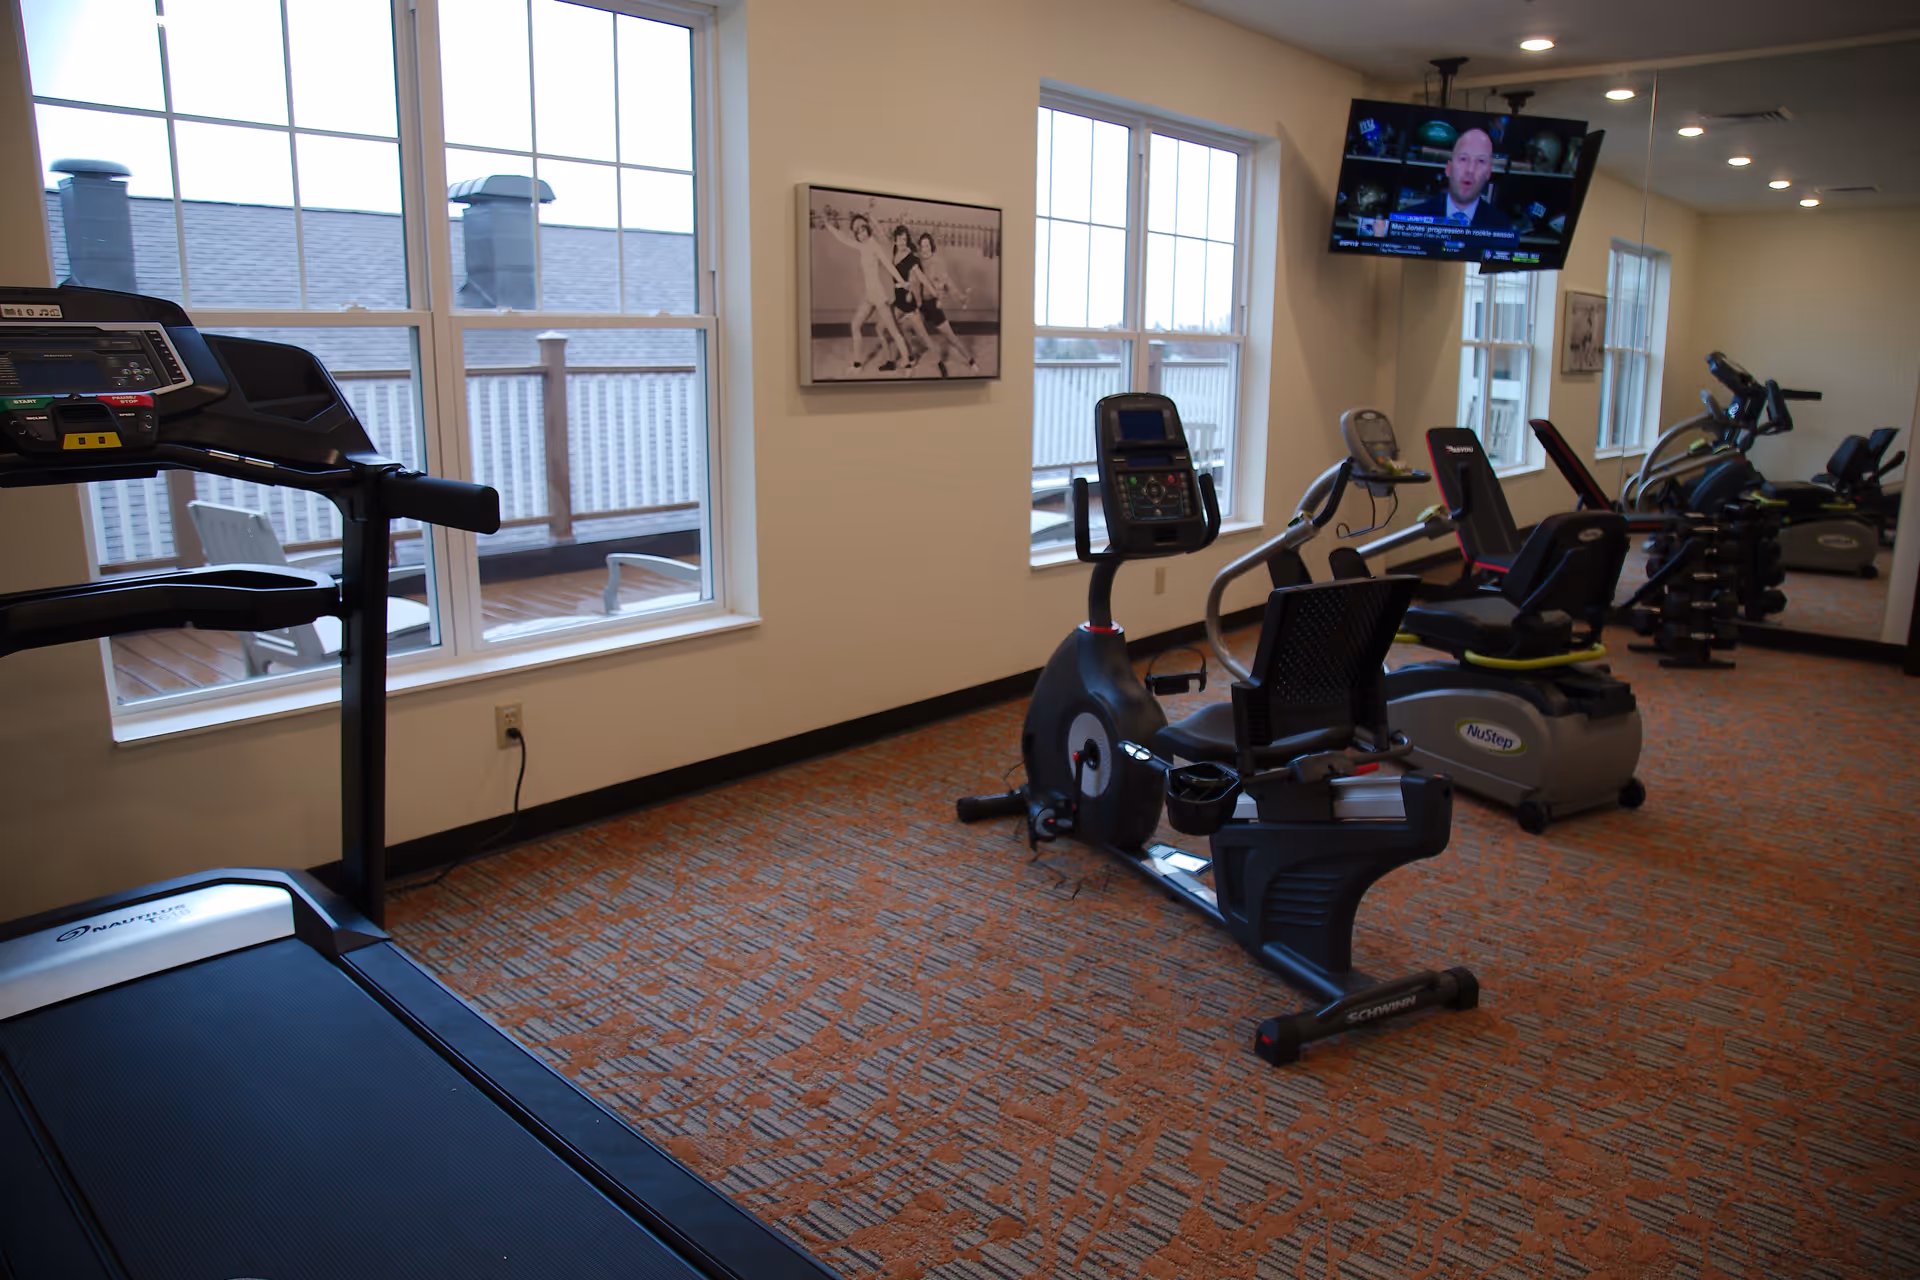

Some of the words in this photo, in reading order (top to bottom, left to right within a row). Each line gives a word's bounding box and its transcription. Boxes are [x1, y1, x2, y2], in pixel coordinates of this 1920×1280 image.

[1391, 222, 1405, 231] Mac
[1427, 225, 1464, 235] progression
[1472, 228, 1492, 237] rookie
[1493, 230, 1515, 239] season
[1467, 724, 1514, 750] NuStep
[92, 903, 187, 933] NAUTILUS
[1345, 995, 1417, 1024] SCHWINN
